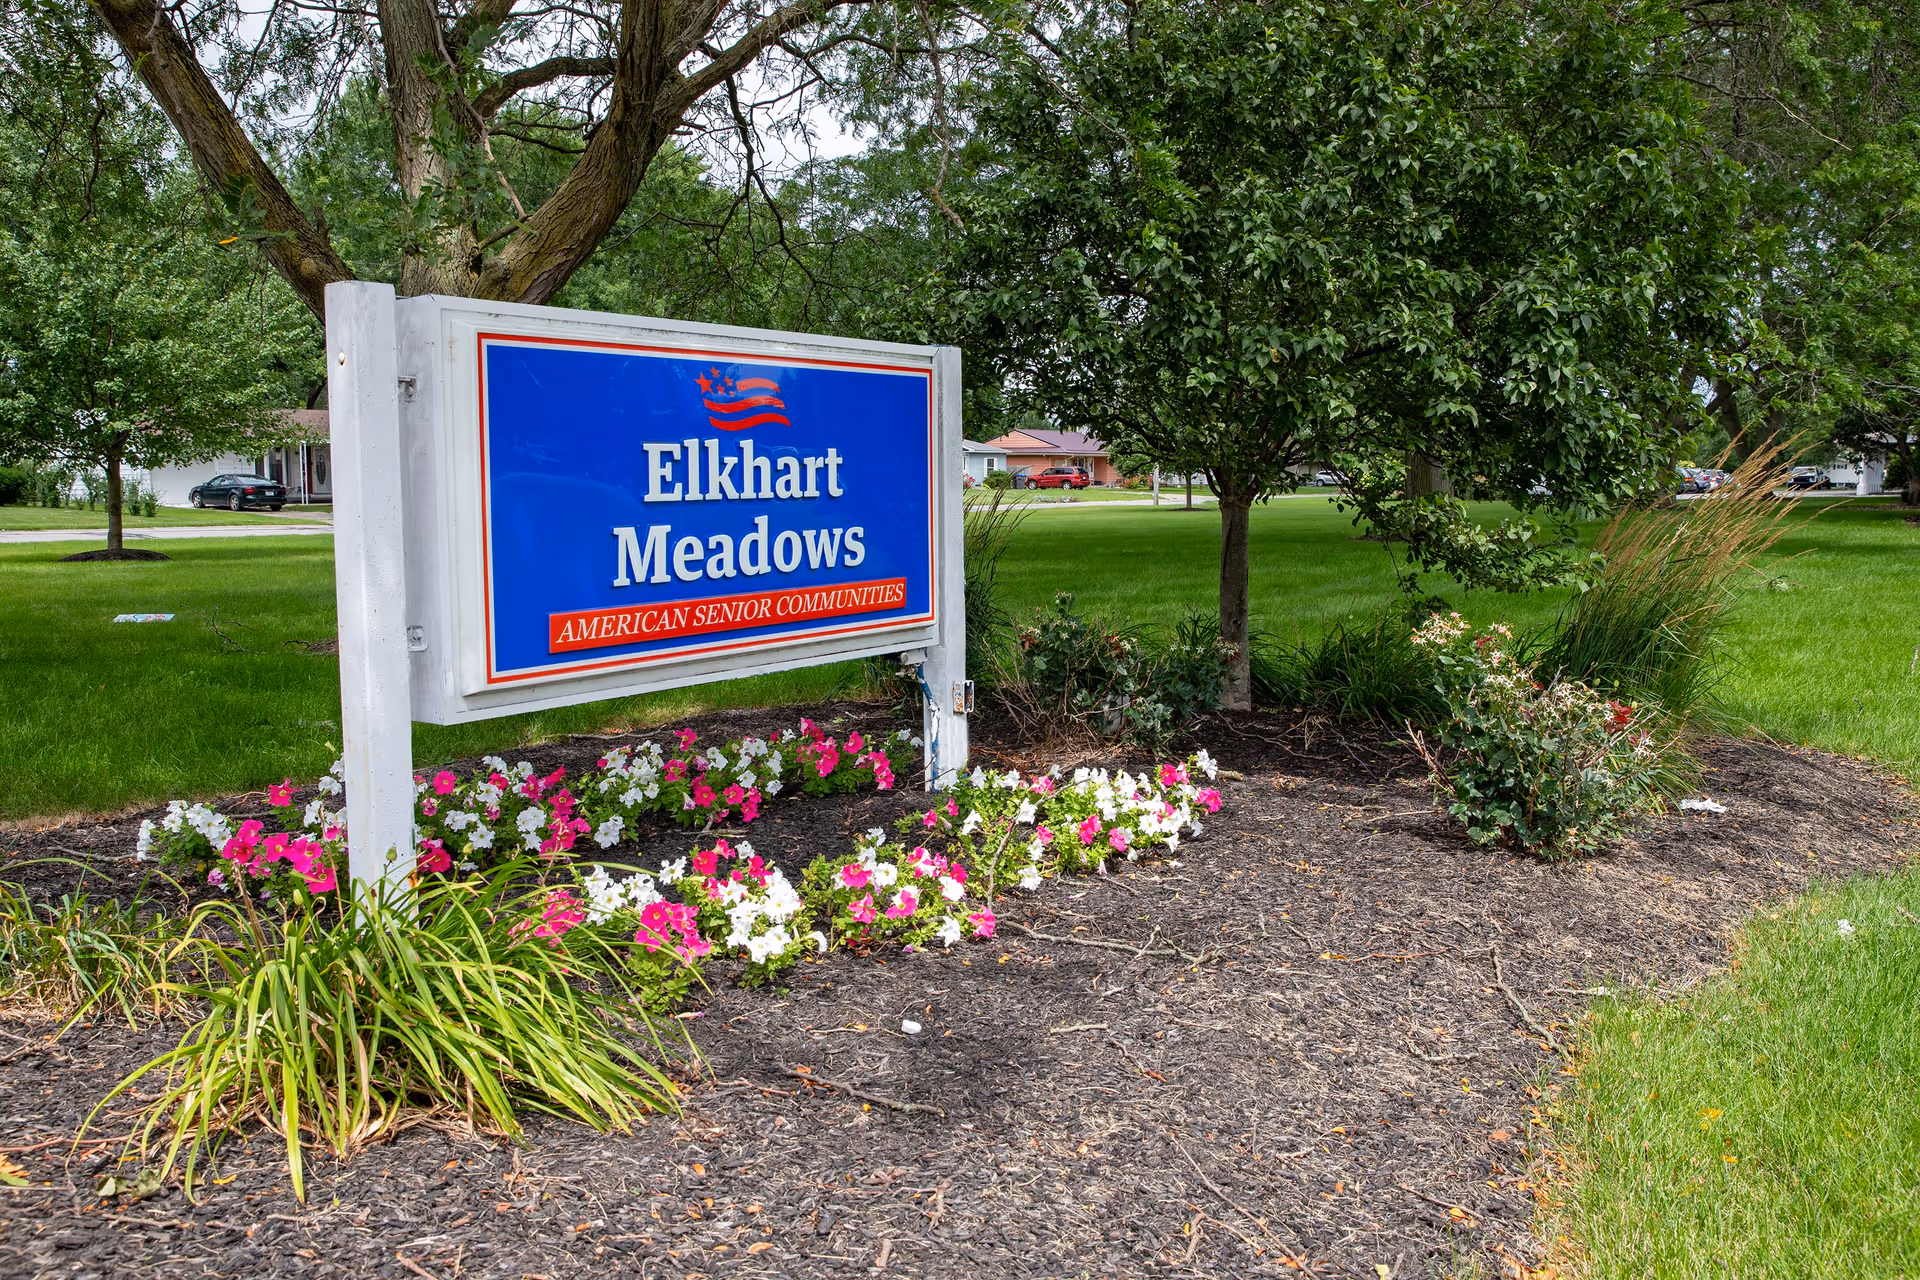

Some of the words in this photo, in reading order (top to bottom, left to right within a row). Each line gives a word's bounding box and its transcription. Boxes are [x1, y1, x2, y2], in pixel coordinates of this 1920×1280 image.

[643, 438, 843, 502] Elkhart
[612, 514, 866, 587] Meadows
[556, 607, 691, 643] AMERICAN
[693, 597, 772, 627] SENIOR
[776, 582, 905, 616] COMMUNITIES
